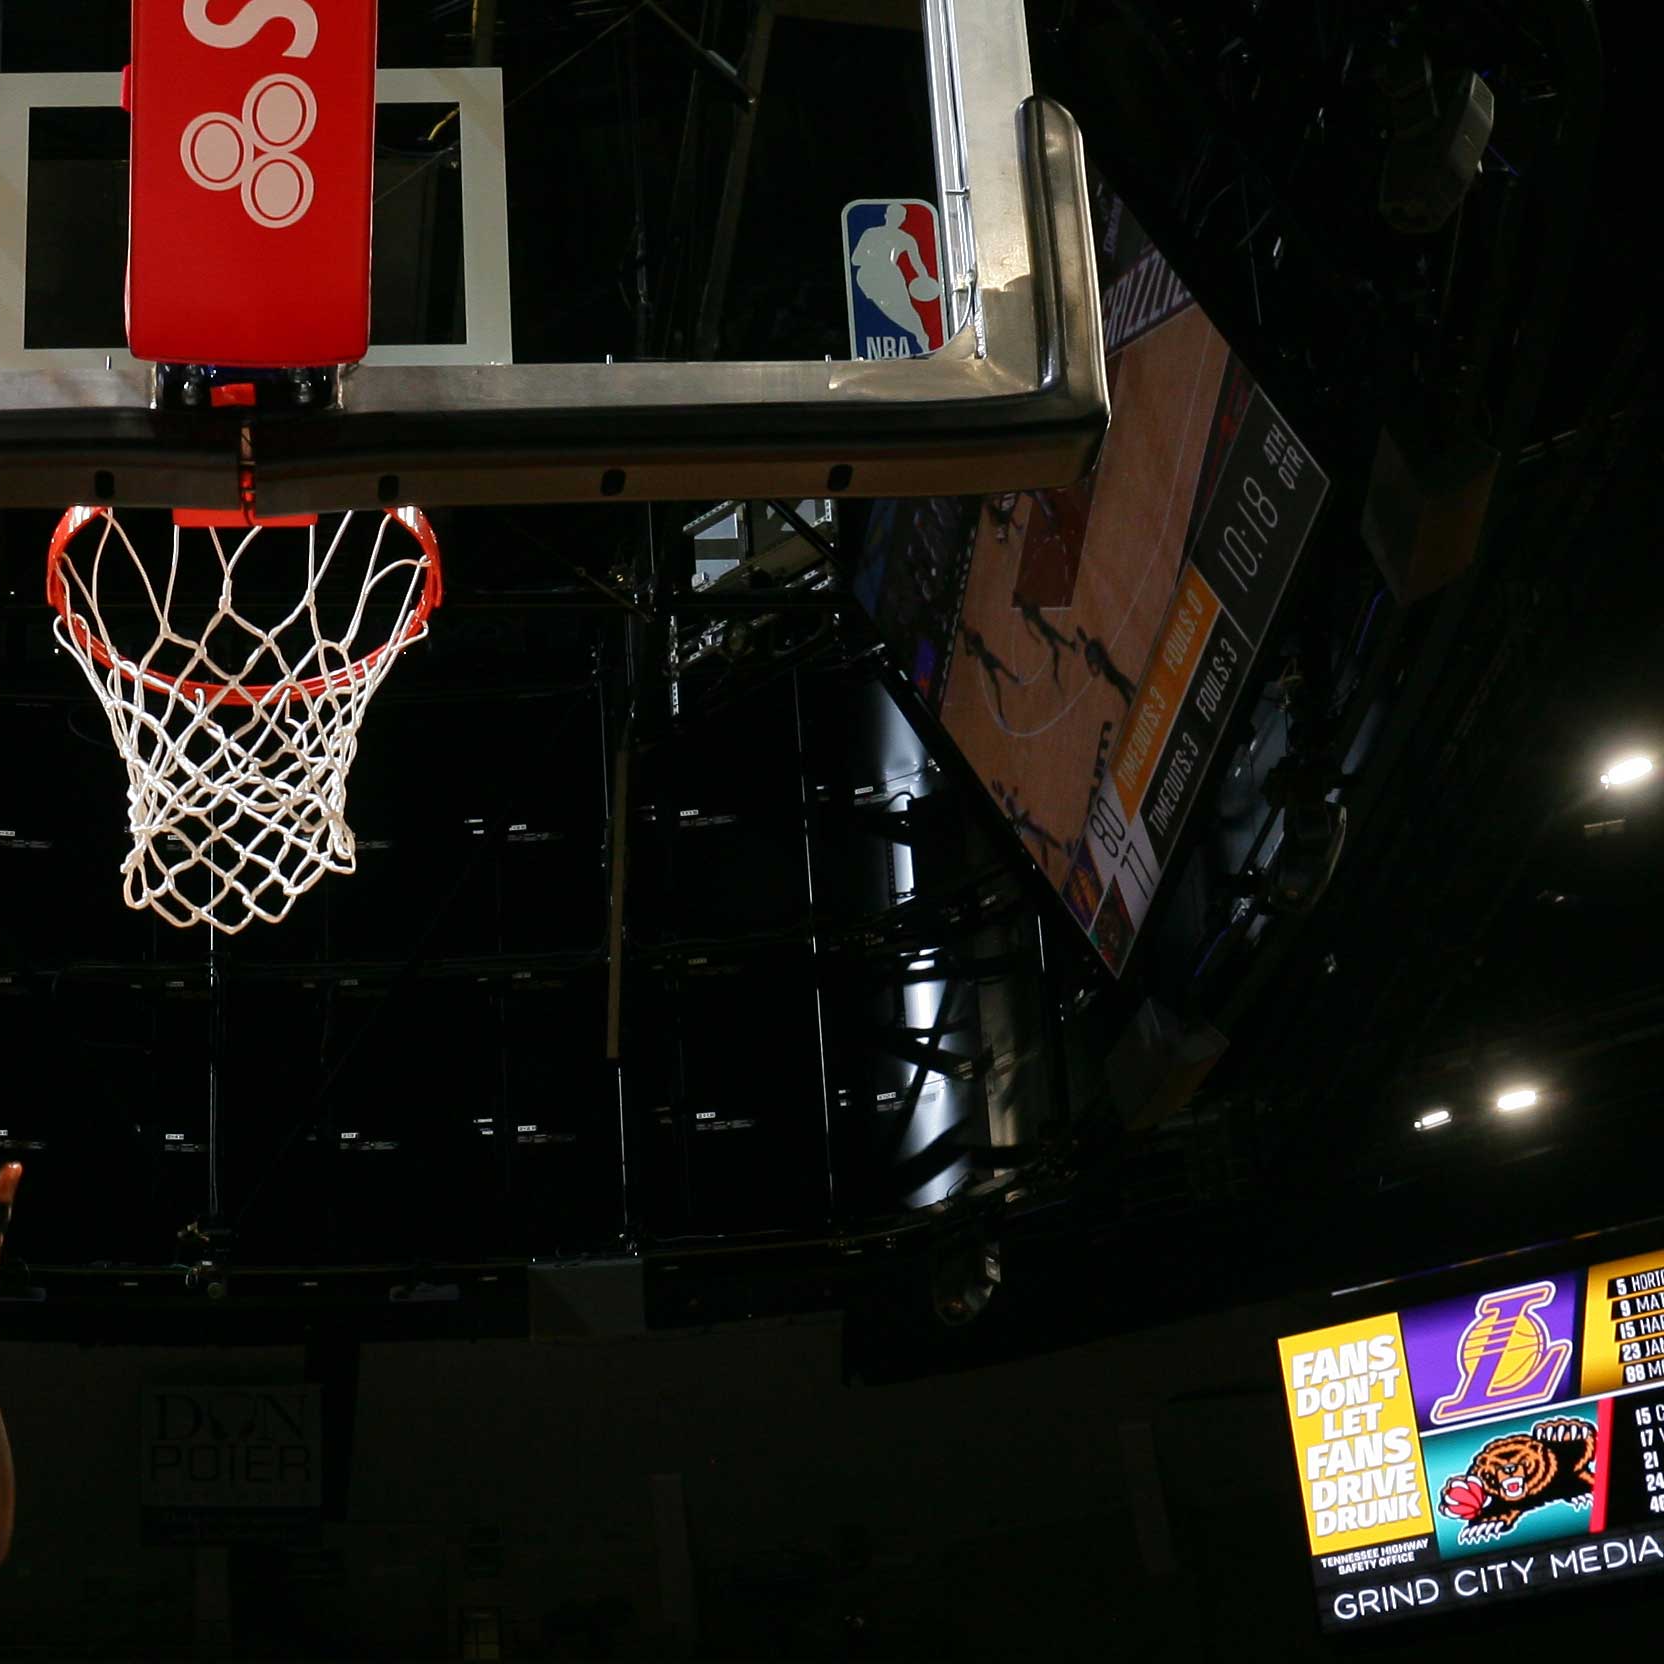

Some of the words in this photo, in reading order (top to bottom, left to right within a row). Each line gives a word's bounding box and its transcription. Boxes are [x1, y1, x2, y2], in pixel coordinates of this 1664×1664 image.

[866, 336, 912, 358] NBA
[1263, 423, 1287, 465] 4TH
[1217, 476, 1278, 592] 10:18
[1090, 797, 1125, 858] 80
[1120, 841, 1154, 900] 77
[1616, 1278, 1628, 1296] 5
[1619, 1299, 1631, 1317] 9
[1620, 1320, 1636, 1339] 15
[1292, 1335, 1396, 1389] FANS
[1622, 1341, 1641, 1362] 23
[1625, 1363, 1646, 1384] 88
[1296, 1368, 1400, 1418] DON'T
[1322, 1402, 1383, 1441] LET
[1635, 1406, 1652, 1425] 15
[1306, 1427, 1413, 1480] FANS
[1640, 1428, 1654, 1447] 17
[1643, 1450, 1659, 1470] 21
[1311, 1461, 1416, 1512] DRIVE
[1316, 1491, 1421, 1537] DRUNK
[1321, 1548, 1379, 1568] TENNESSEE
[1381, 1539, 1429, 1558] HIGHWAY
[1338, 1558, 1377, 1575] SAFETY
[1379, 1551, 1415, 1568] OFFICE
[1333, 1578, 1440, 1620] GRIND
[1454, 1556, 1535, 1597] CITY
[1550, 1535, 1664, 1579] MEDIA
